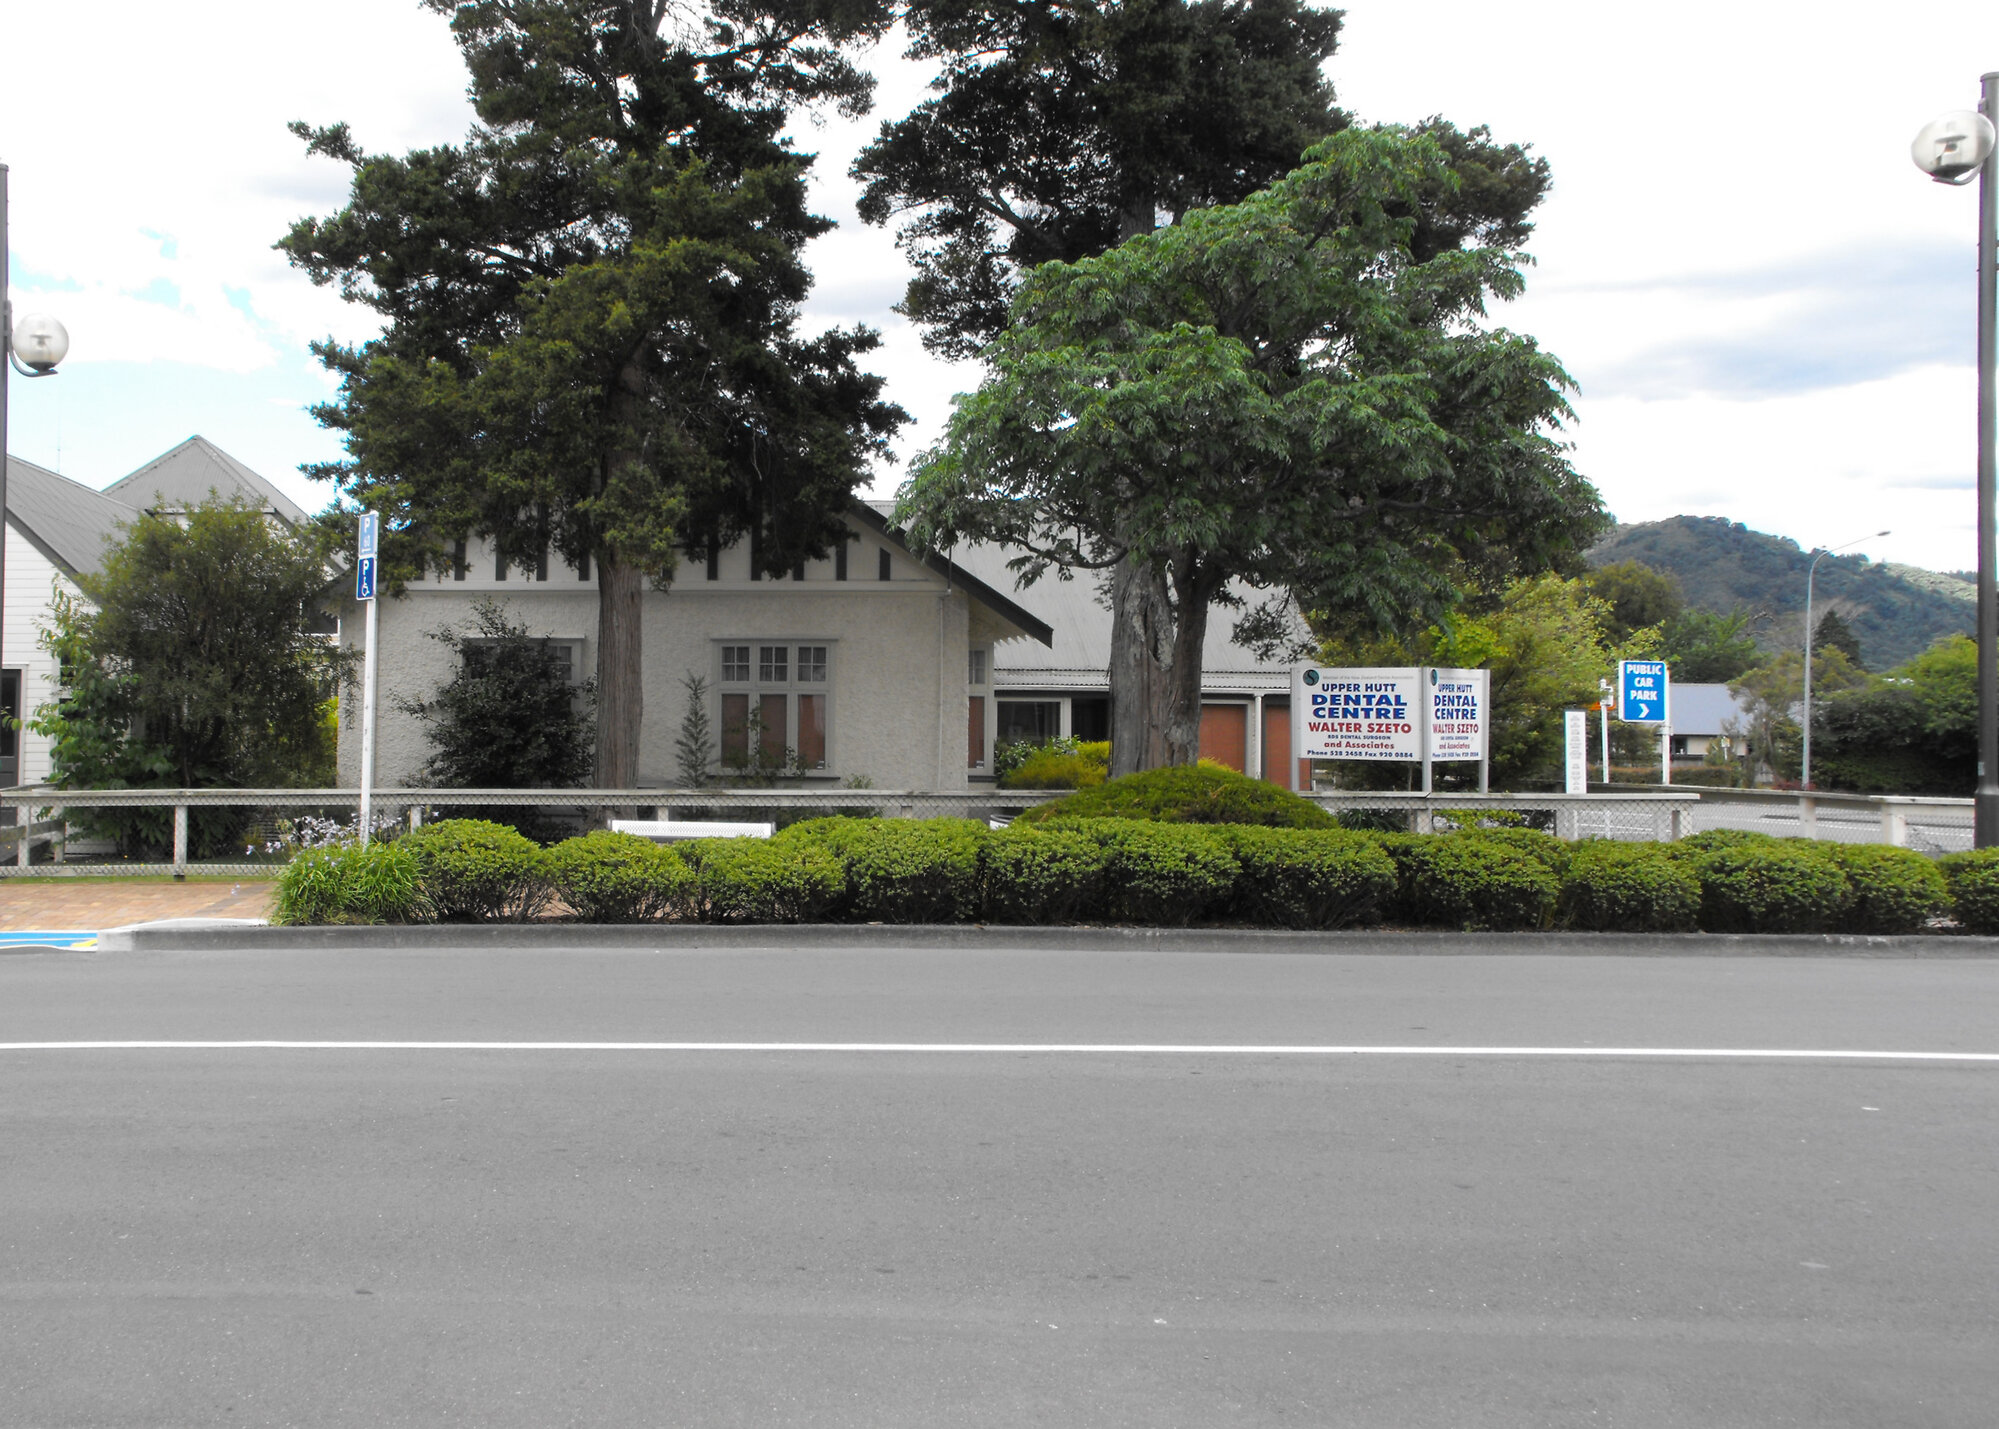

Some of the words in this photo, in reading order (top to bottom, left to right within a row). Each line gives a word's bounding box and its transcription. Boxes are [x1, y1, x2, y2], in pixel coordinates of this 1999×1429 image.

[364, 517, 371, 533] P
[363, 559, 369, 575] P
[1626, 664, 1662, 675] PUBLIC
[1634, 677, 1654, 687] CAR
[1322, 684, 1361, 692] UPPER
[1365, 684, 1396, 692] HUTT
[1438, 684, 1455, 692] UPPER
[1457, 684, 1472, 692] HUTT
[1311, 694, 1408, 706] DENTAL
[1630, 690, 1658, 700] PARK
[1434, 695, 1477, 707] DENTAL
[1313, 707, 1406, 719] CENTRE
[1434, 708, 1477, 720] CENTRE
[1308, 722, 1362, 733] WALTER
[1367, 722, 1412, 734] SZETO
[1432, 724, 1454, 733] WALTER
[1456, 724, 1479, 733] SZETO
[1345, 741, 1395, 749] Associates
